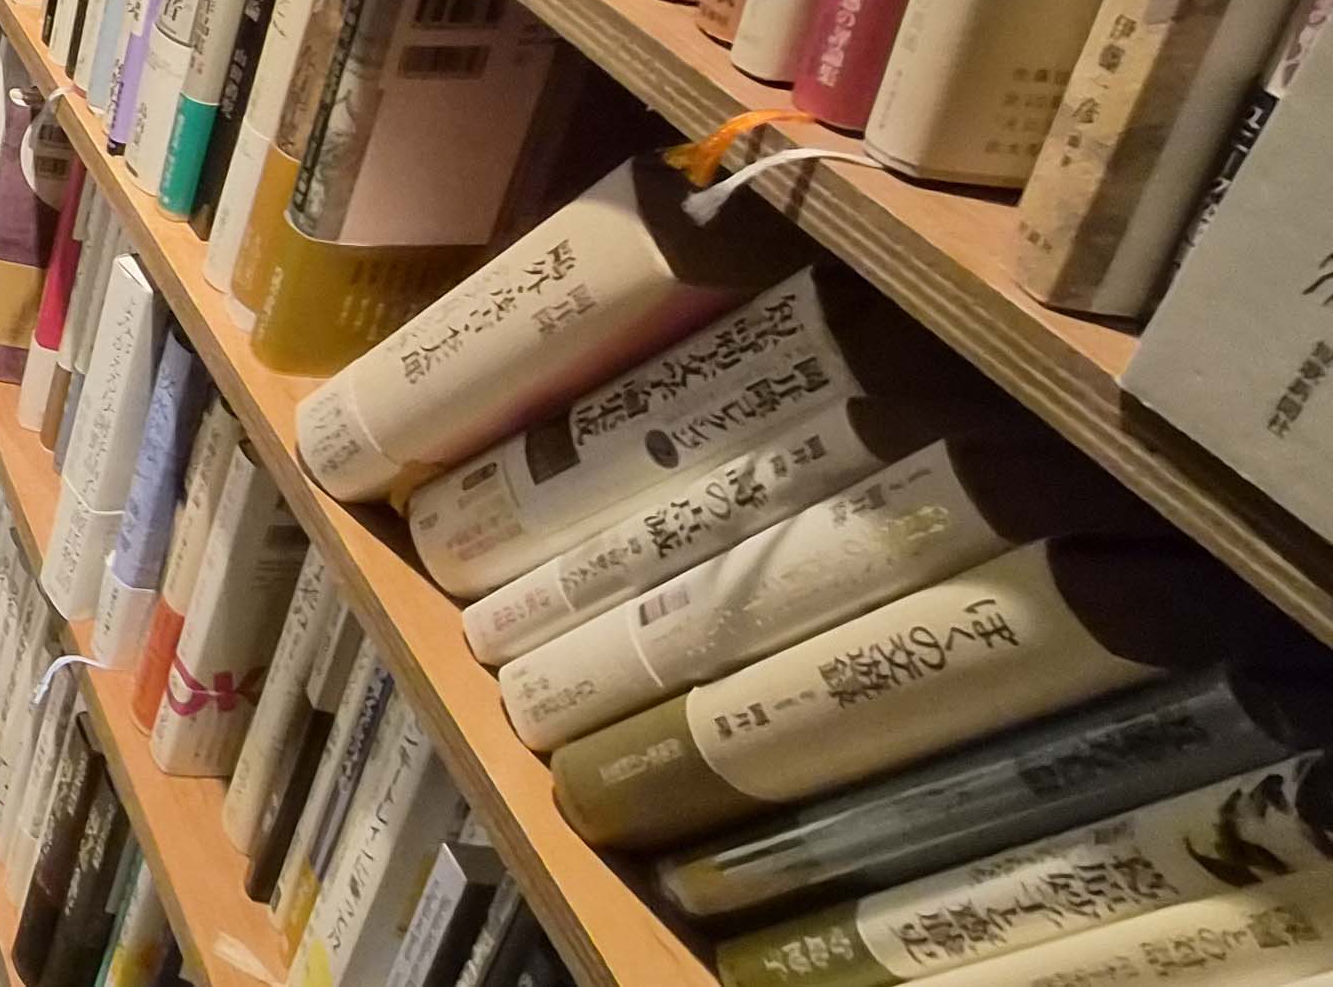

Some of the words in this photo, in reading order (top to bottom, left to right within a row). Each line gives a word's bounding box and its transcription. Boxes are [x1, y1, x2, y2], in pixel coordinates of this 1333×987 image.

[817, 597, 1019, 707] ぼくの交遊録
